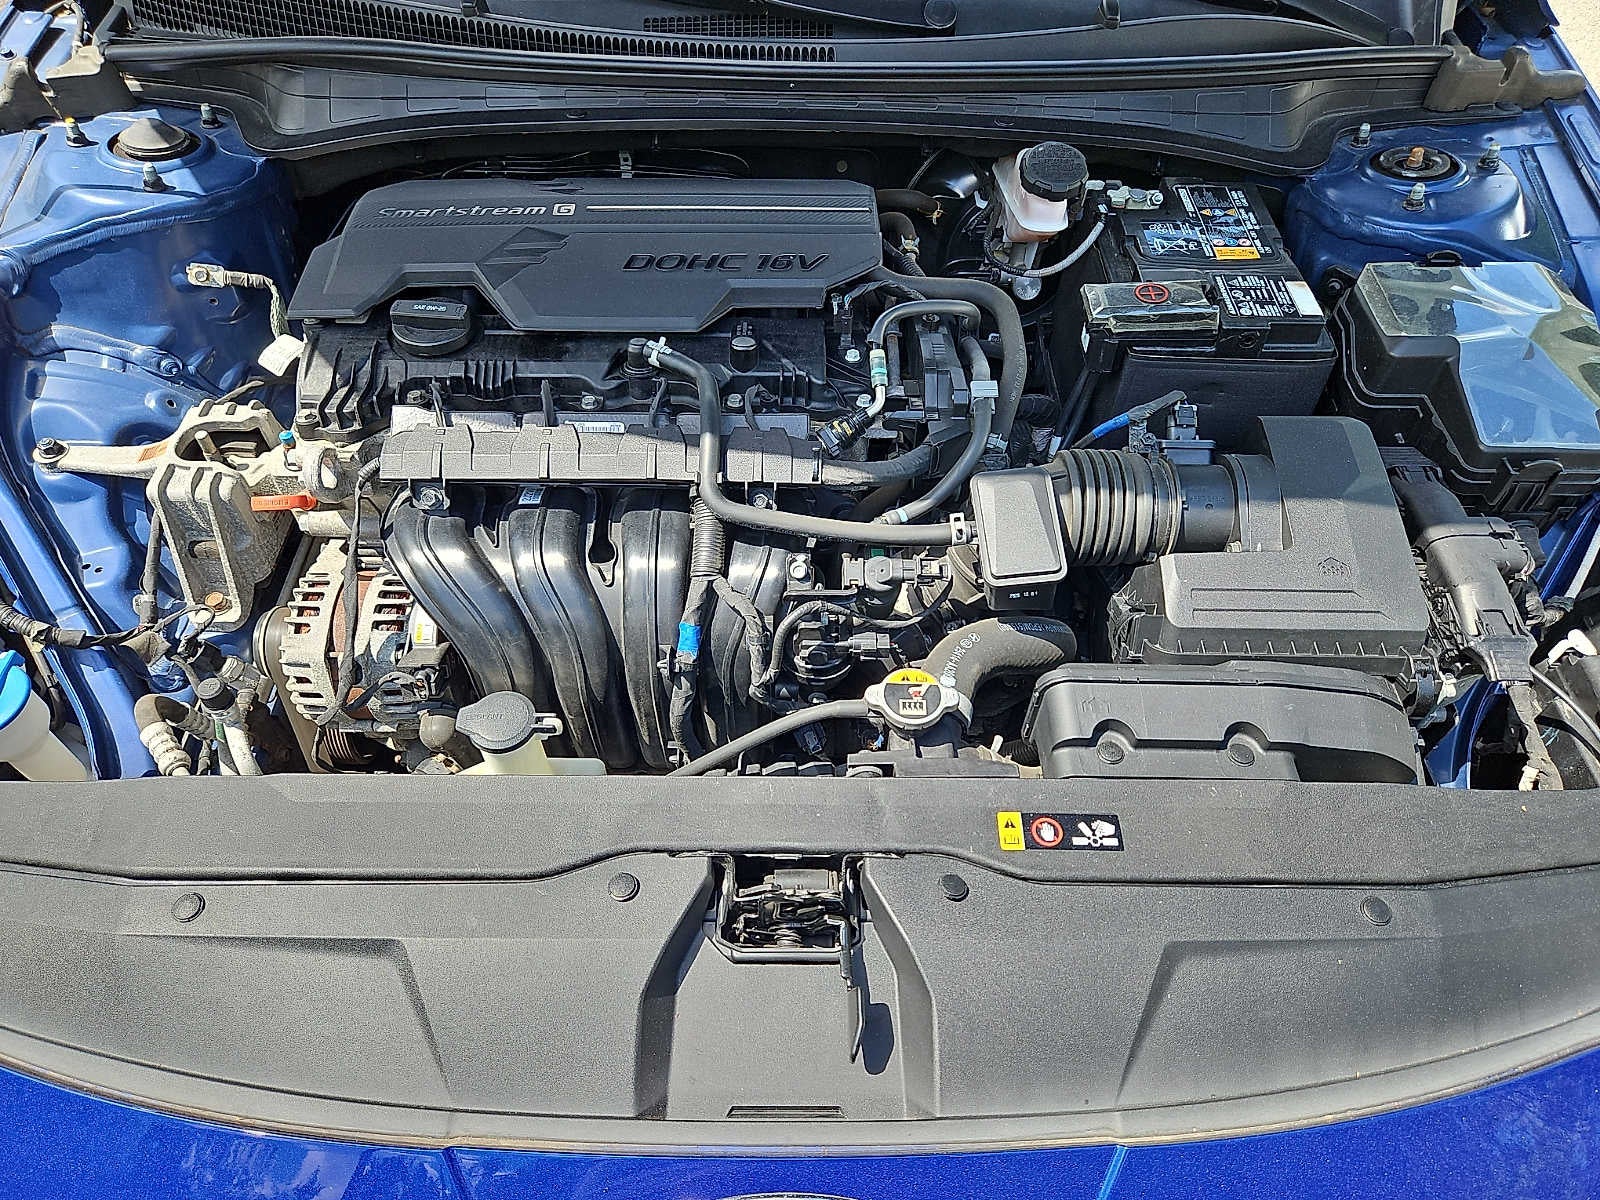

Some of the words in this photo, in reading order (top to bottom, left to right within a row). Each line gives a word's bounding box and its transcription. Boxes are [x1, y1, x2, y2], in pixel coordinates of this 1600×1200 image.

[379, 204, 547, 219] Smartstream
[552, 203, 575, 216] G
[622, 253, 748, 272] DOHC
[757, 253, 829, 272] 16V
